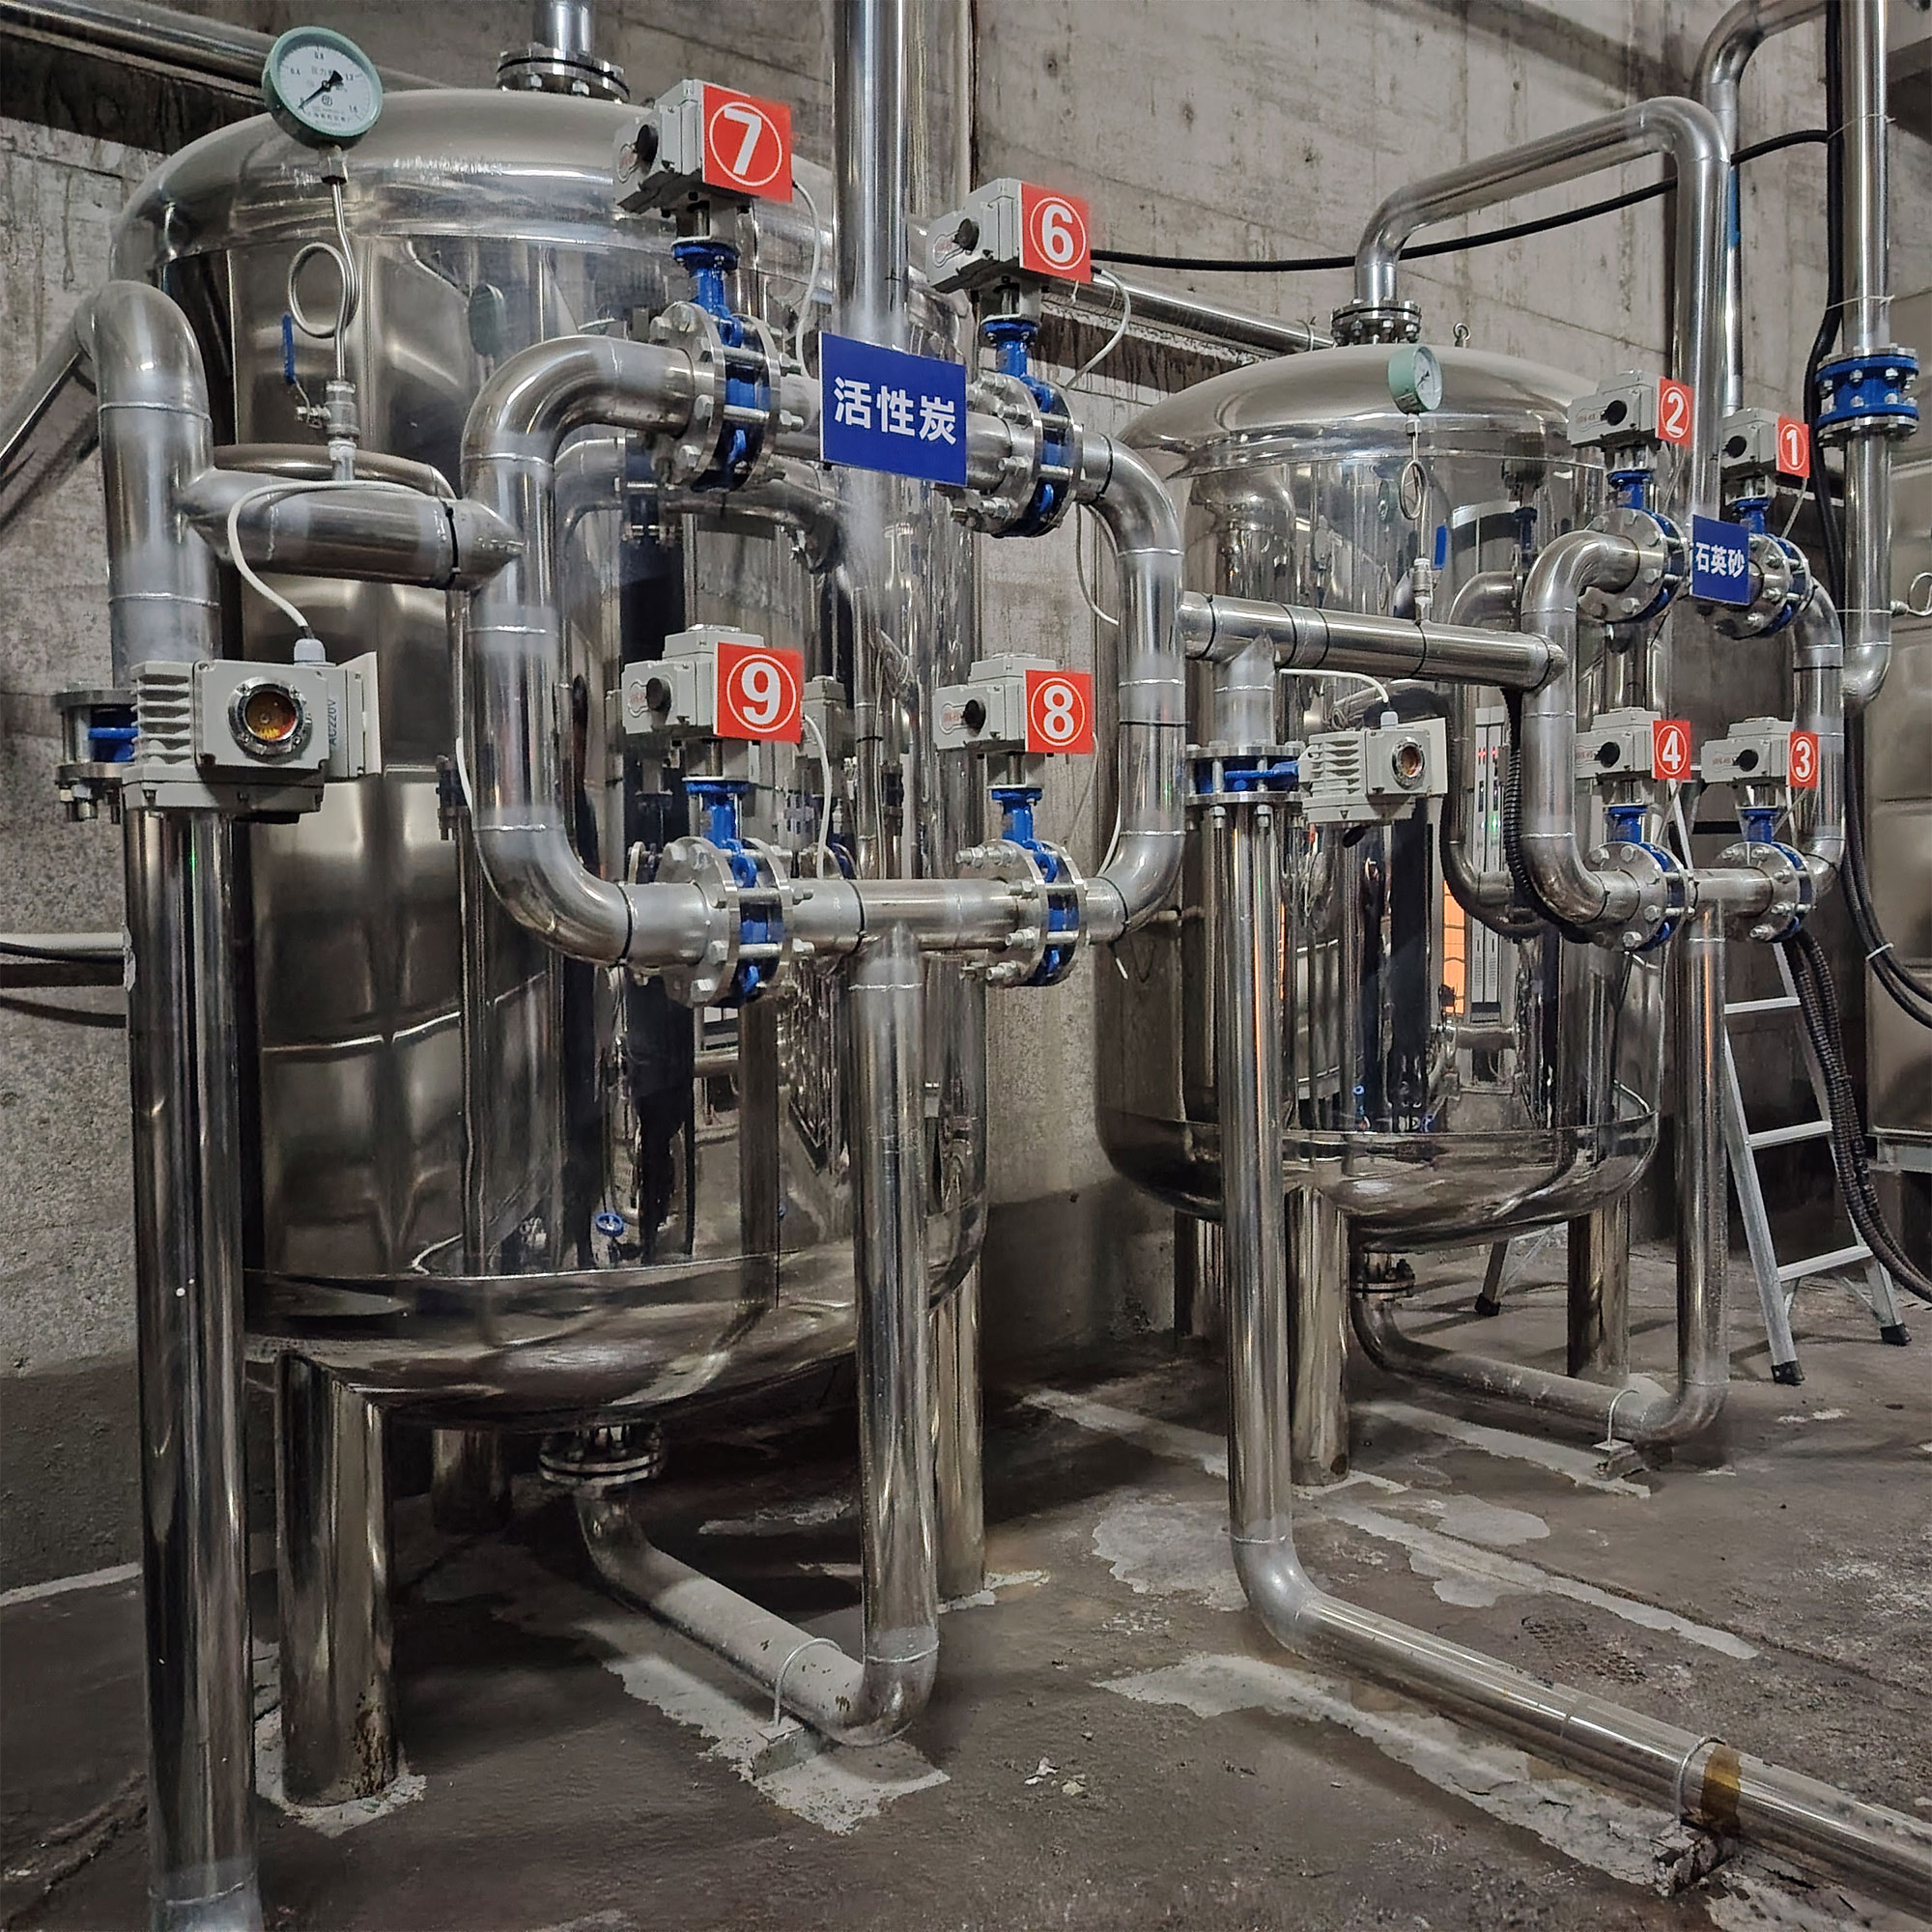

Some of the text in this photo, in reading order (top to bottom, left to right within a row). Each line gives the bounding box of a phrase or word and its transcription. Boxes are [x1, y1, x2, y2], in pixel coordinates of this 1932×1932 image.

[724, 106, 762, 176] 7
[1041, 203, 1074, 264] 6
[833, 376, 957, 445] 活性炭
[1666, 391, 1685, 436] 2
[1785, 429, 1799, 467] 1
[1695, 541, 1746, 579] 石英砂
[741, 661, 781, 724] 9
[1043, 684, 1074, 740] 8
[327, 698, 338, 747] AC220V
[1662, 730, 1682, 770] 4
[1795, 741, 1811, 779] 3
